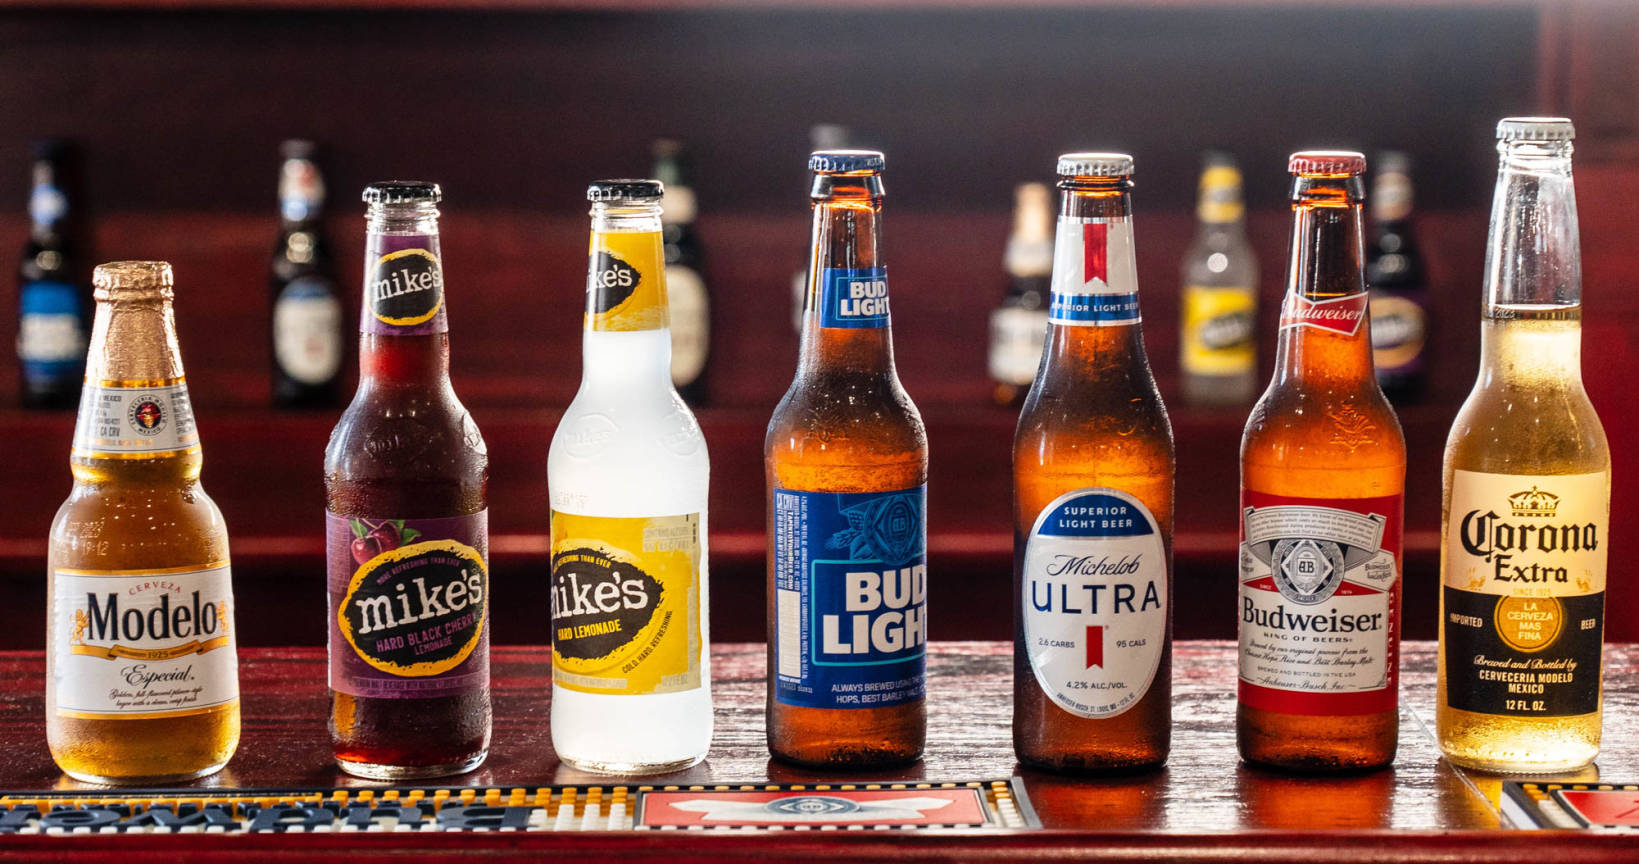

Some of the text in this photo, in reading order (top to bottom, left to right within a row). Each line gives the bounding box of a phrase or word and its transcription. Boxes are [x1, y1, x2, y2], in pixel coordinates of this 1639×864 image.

[586, 264, 633, 293] ke's
[850, 281, 886, 299] BUD
[1094, 304, 1121, 312] LIGHT
[1286, 304, 1361, 321] udweiser
[1064, 506, 1127, 516] SUPERIOR
[1059, 519, 1133, 529] LIGHT BEER
[1460, 510, 1598, 563] Corona
[1047, 553, 1143, 577] Michelob
[1494, 554, 1568, 583] Extra
[128, 581, 181, 596] CERVEZA
[846, 563, 926, 612] BUD
[355, 569, 482, 635] mike's
[1032, 580, 1161, 614] ULTRA
[1523, 602, 1538, 611] LA
[87, 590, 217, 641] Modelo
[1243, 596, 1382, 633] Budweiser
[1450, 612, 1483, 628] IMPORTED
[1506, 611, 1554, 621] CERVEZA
[557, 618, 622, 641] HARD LEMONADE
[823, 605, 927, 655] LIGH
[1519, 622, 1542, 631] MAS
[1580, 618, 1596, 631] BEER
[375, 635, 405, 653] HARD
[407, 625, 442, 647] BLACK
[1038, 637, 1075, 649] 2.6 CARBS
[1116, 638, 1147, 649] 95 CALS
[1263, 632, 1288, 641] KING
[1518, 631, 1542, 641] FINA
[414, 635, 453, 656] LEMONADE
[1473, 654, 1578, 672] Brewed and Bottled by
[1479, 669, 1573, 684] CERVECERIA MODELO
[831, 683, 864, 693] ALWAYS
[864, 681, 895, 692] BREWED
[1066, 681, 1128, 690] 4.2% ALC./VOL.
[1508, 683, 1544, 695] MEXICO
[836, 694, 860, 704] HOPS,
[861, 693, 881, 703] BEST
[1505, 699, 1547, 712] 12 FL. OZ.
